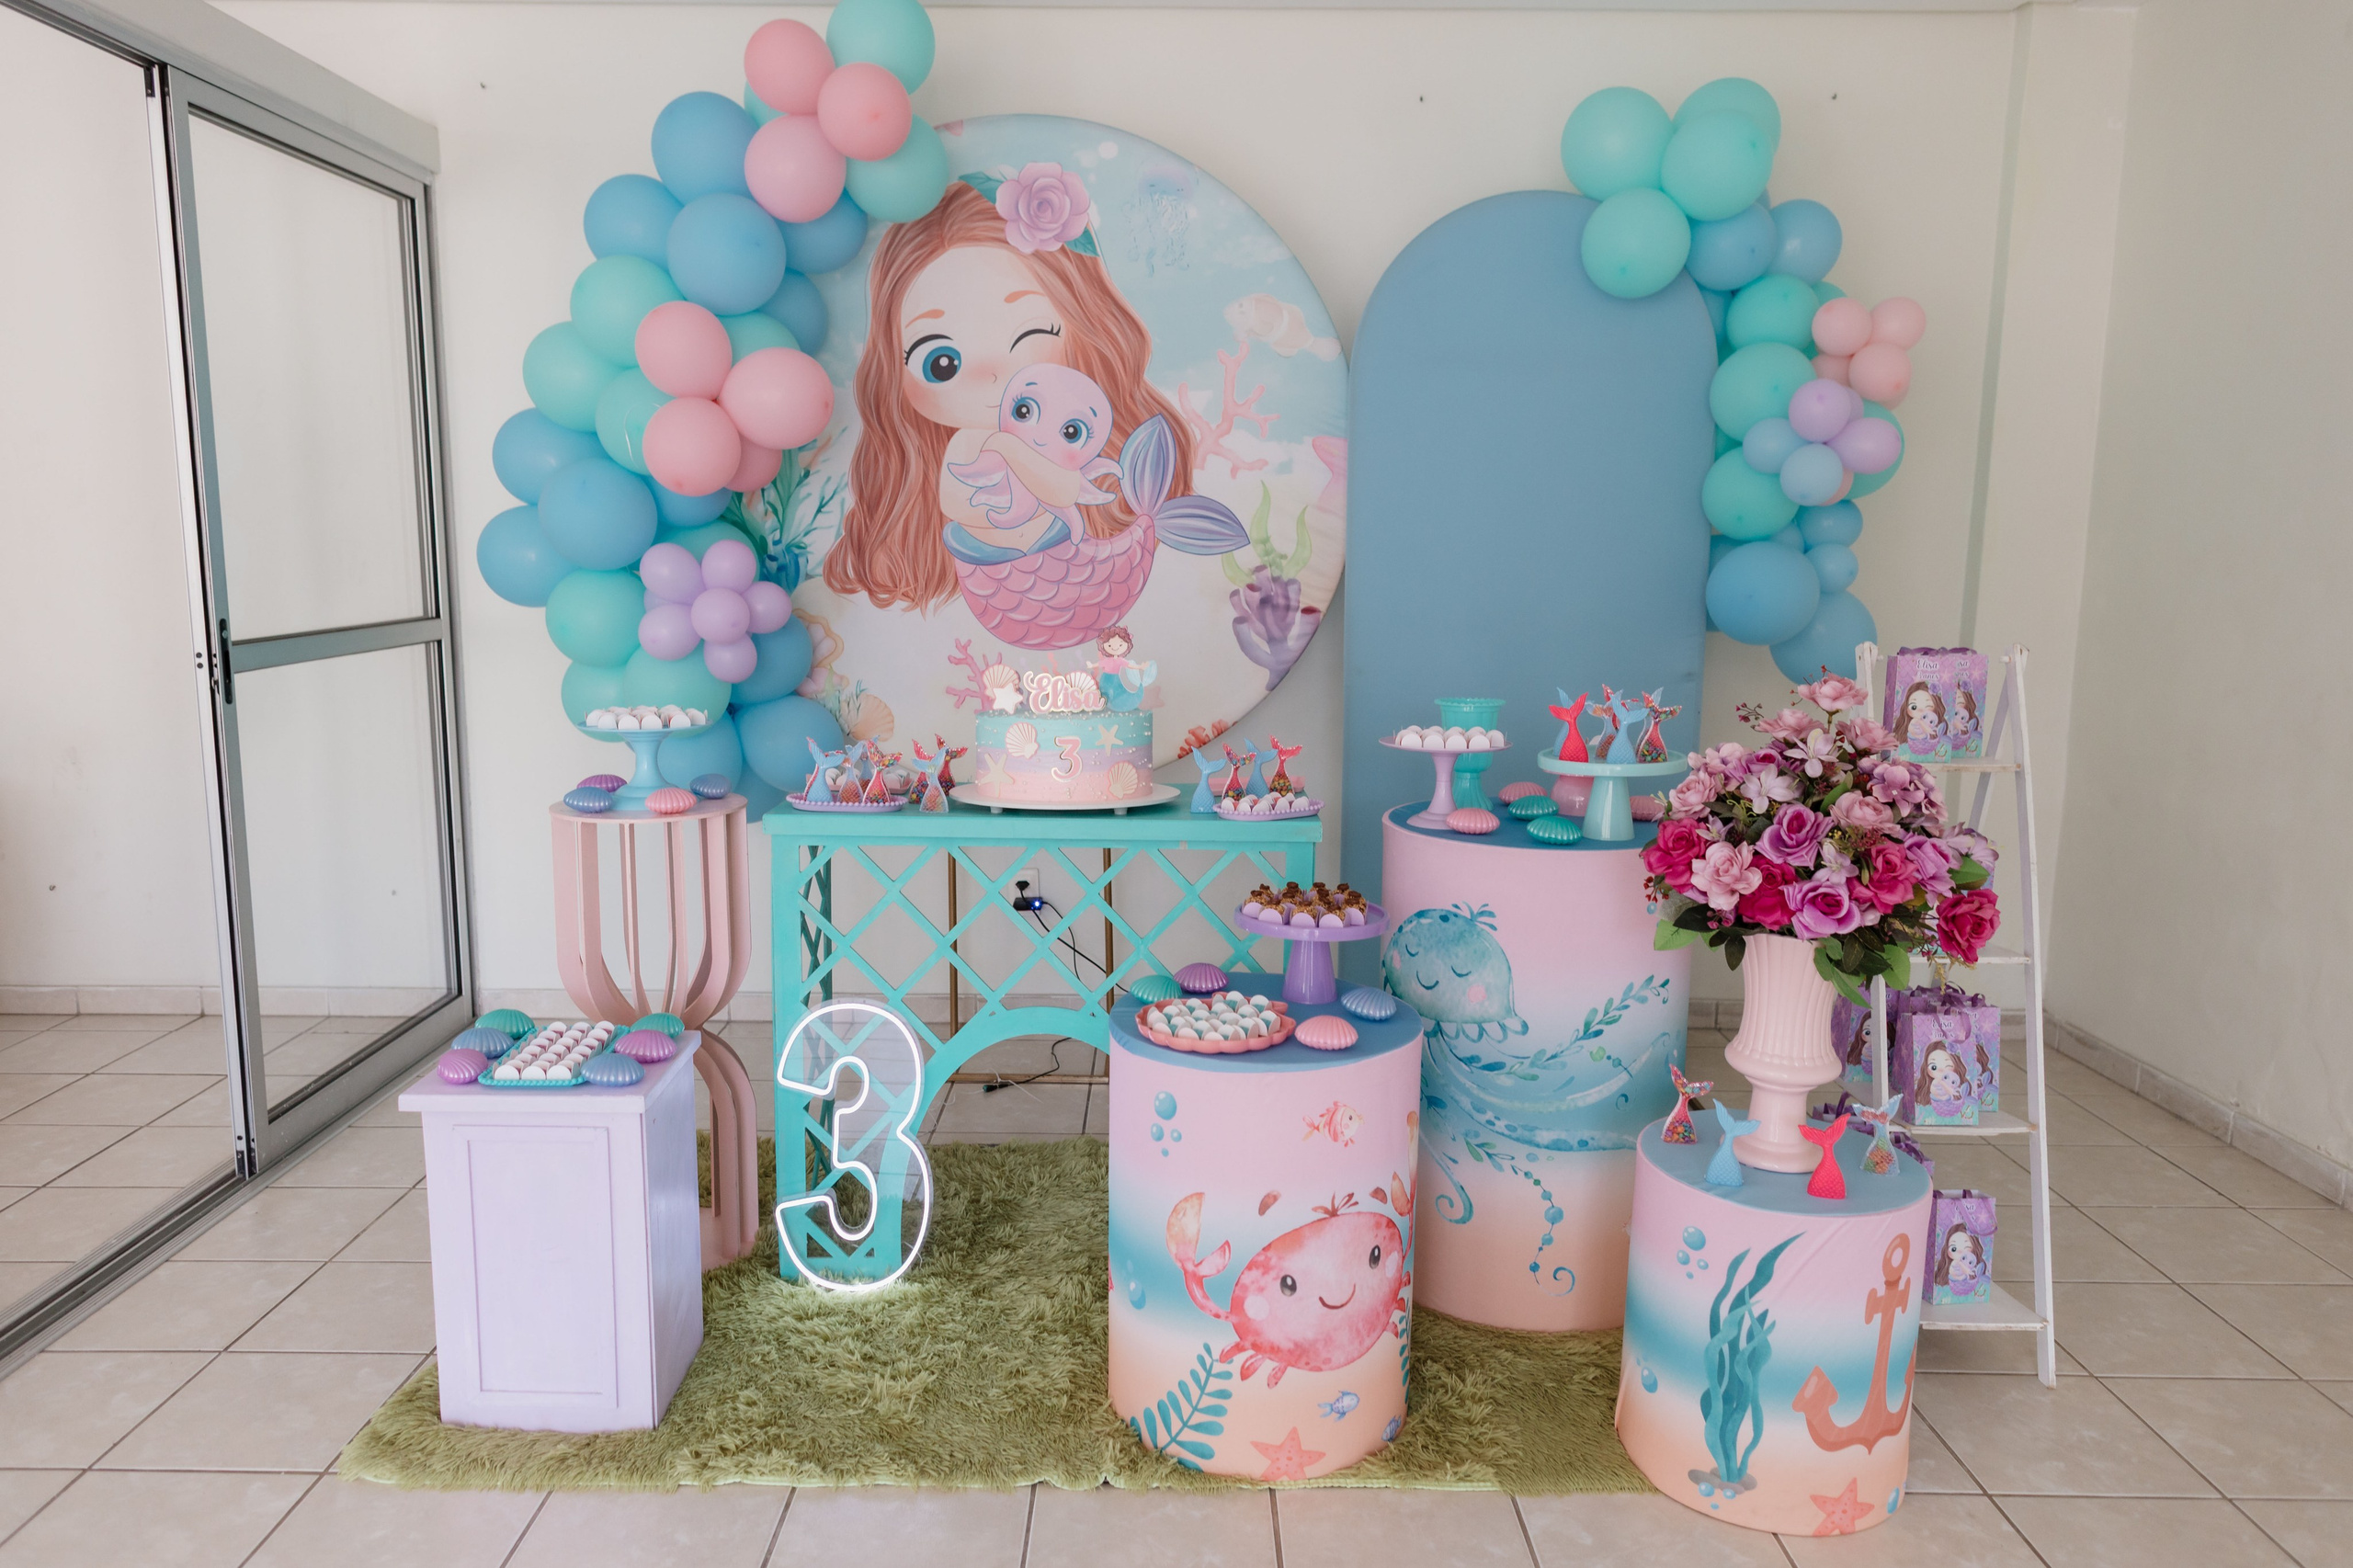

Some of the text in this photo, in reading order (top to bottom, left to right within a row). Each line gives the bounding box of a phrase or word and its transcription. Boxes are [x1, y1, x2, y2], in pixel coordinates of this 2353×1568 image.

[1916, 659, 1938, 670] Elisa
[1023, 671, 1107, 714] Elisa
[1051, 735, 1083, 782] 3
[1931, 1018, 1952, 1028] Eisa
[776, 1000, 932, 1290] 3
